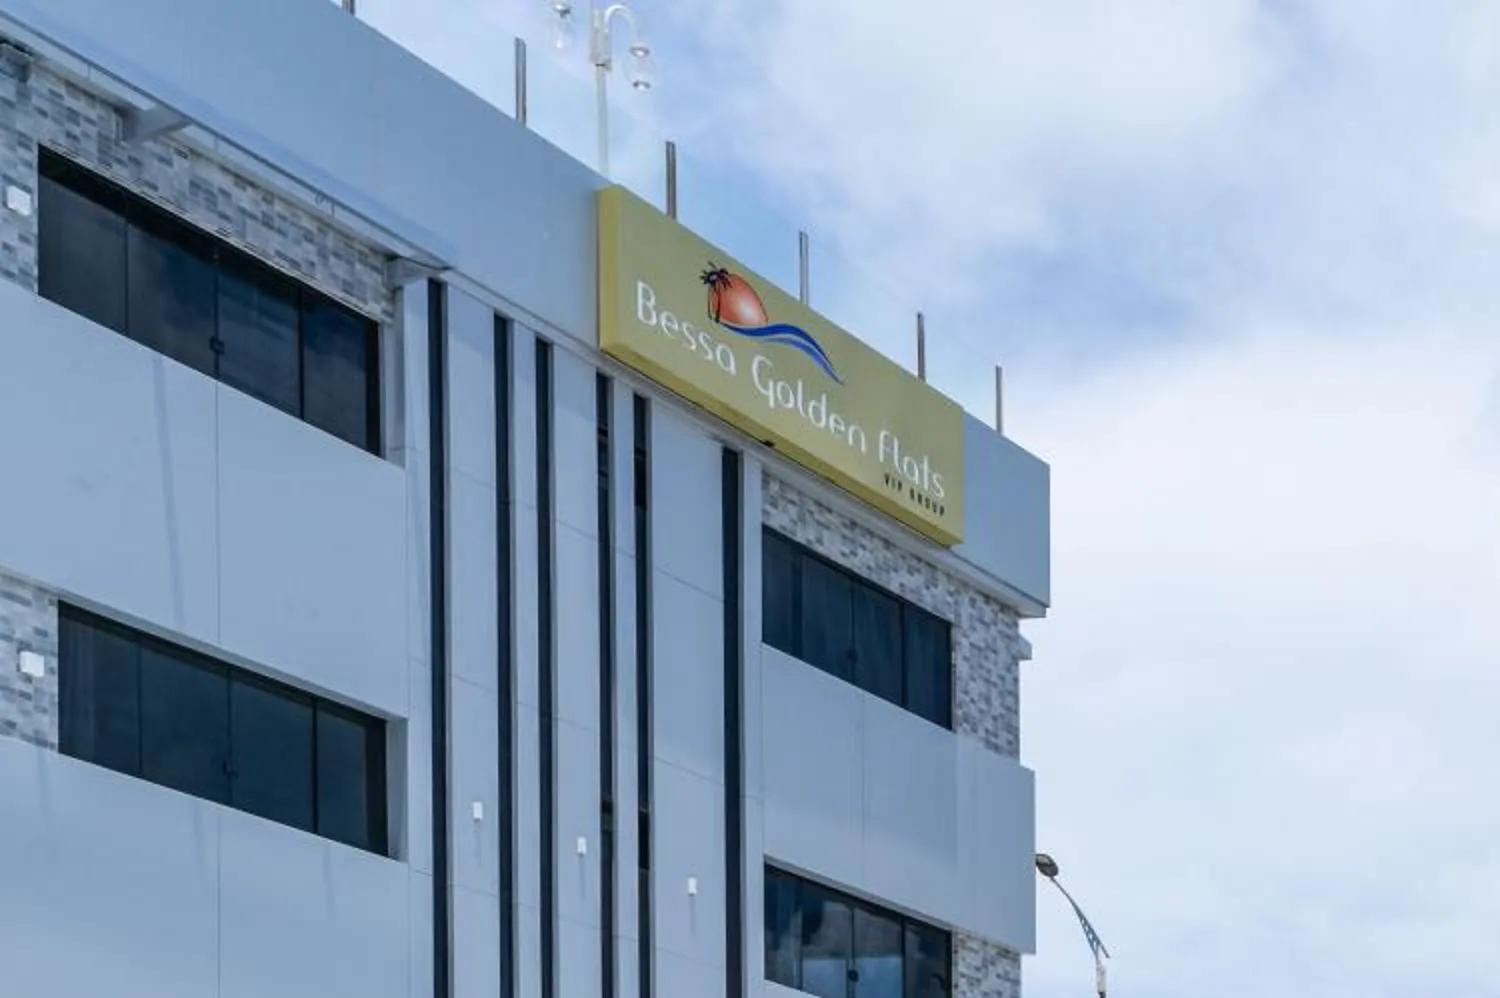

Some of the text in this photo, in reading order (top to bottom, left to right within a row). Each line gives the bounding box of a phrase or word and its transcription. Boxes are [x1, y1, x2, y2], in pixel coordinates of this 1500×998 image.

[636, 281, 945, 498] Bessa Golden Flats
